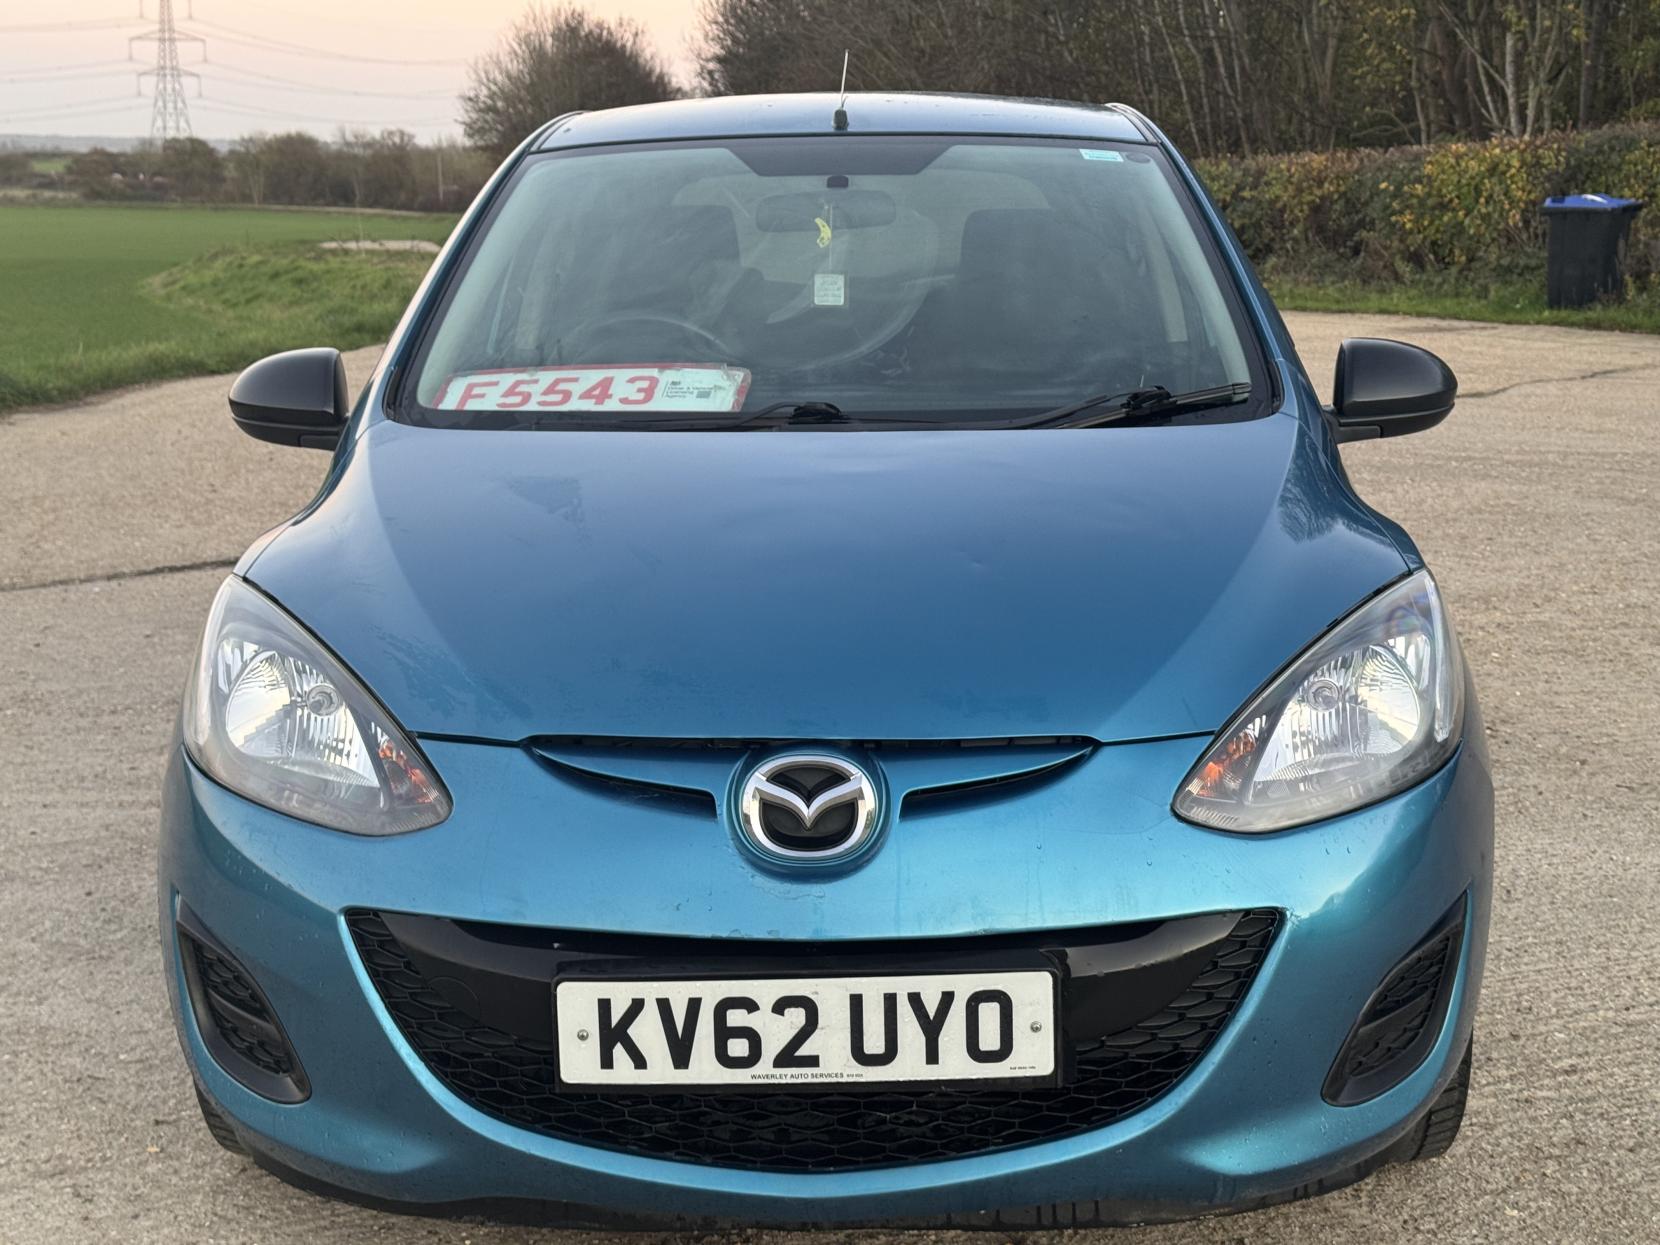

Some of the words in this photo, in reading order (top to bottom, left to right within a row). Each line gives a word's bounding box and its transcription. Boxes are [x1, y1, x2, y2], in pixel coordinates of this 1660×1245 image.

[454, 376, 660, 411] F5543
[597, 995, 820, 1070] KV62
[849, 989, 1014, 1067] UYO
